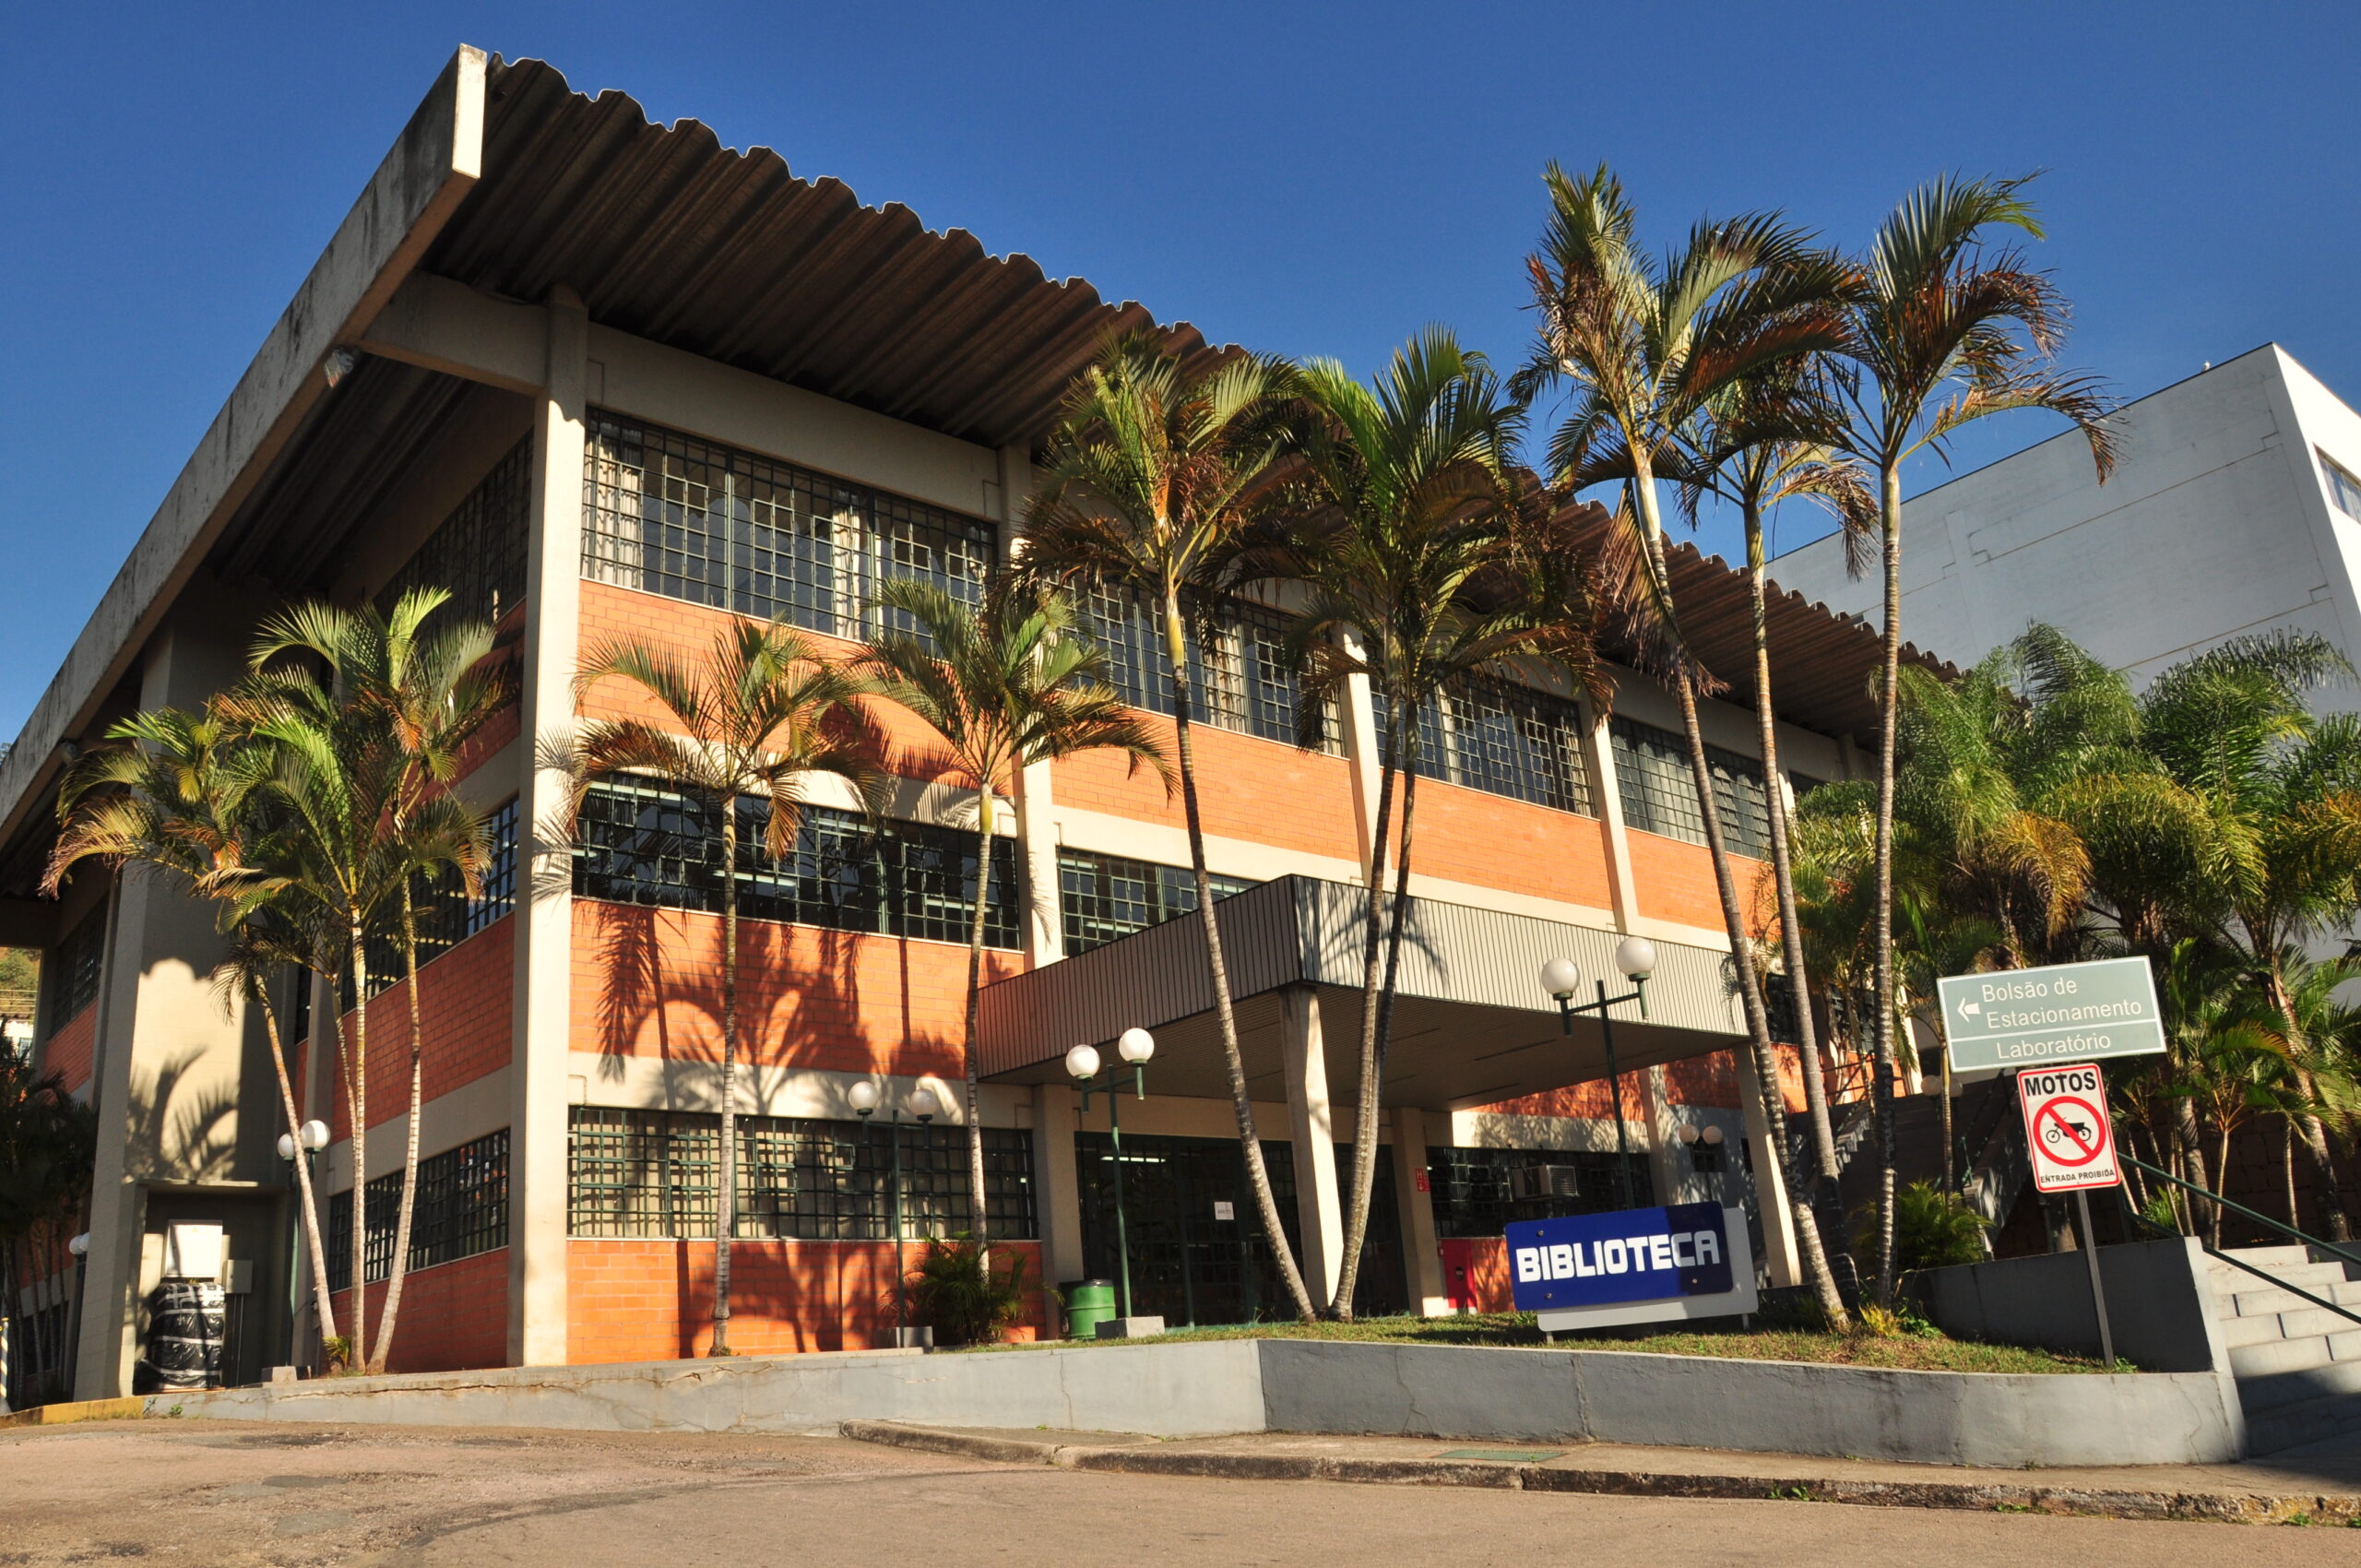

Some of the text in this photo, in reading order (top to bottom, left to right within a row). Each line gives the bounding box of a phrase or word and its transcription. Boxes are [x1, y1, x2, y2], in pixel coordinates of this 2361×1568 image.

[1982, 977, 2078, 1003] Bolsão de
[1987, 1000, 2142, 1029] Estacionamento
[1996, 1033, 2111, 1060] Laboratório
[2024, 1071, 2096, 1097] MOTOS
[2040, 1169, 2115, 1183] ENTRADA PROIBIDA
[1515, 1229, 1720, 1283] BIBLIOTECA
